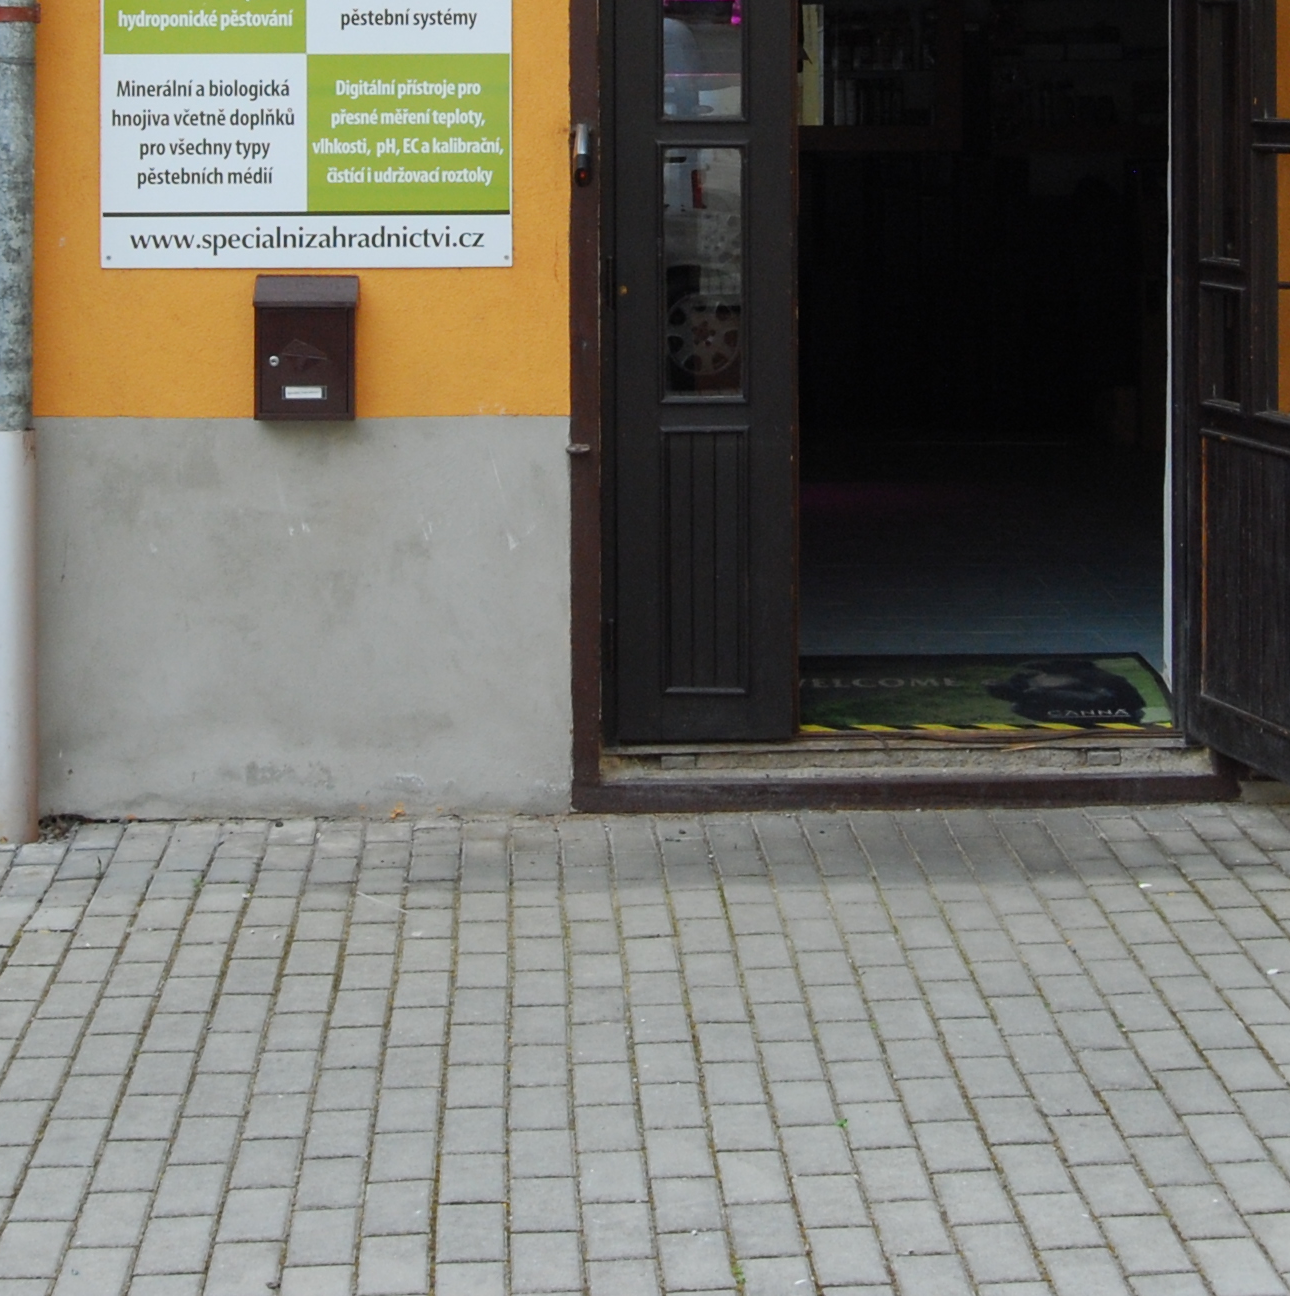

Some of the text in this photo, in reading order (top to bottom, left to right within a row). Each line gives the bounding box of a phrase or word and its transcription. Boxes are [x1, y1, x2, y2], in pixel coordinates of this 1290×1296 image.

[118, 9, 294, 32] hydroponické pěstování
[340, 8, 477, 30] pěstební systémy
[116, 79, 290, 101] Minerální a biologická
[335, 79, 482, 100] Digitální přístroje pro
[112, 107, 295, 131] hnojiva včetně doplňků
[331, 108, 486, 129] přesné měření teploty,
[139, 138, 271, 160] pro všechny typy
[312, 137, 504, 157] vlhkosti, pH, EC a kalibrační,
[137, 166, 273, 189] pěstebních médií
[326, 166, 365, 183] čistící
[374, 166, 440, 183] udržovací
[442, 166, 493, 187] roztoky
[129, 225, 485, 256] www.specialnizahradnictvi.cz
[799, 677, 965, 689] ELCOME
